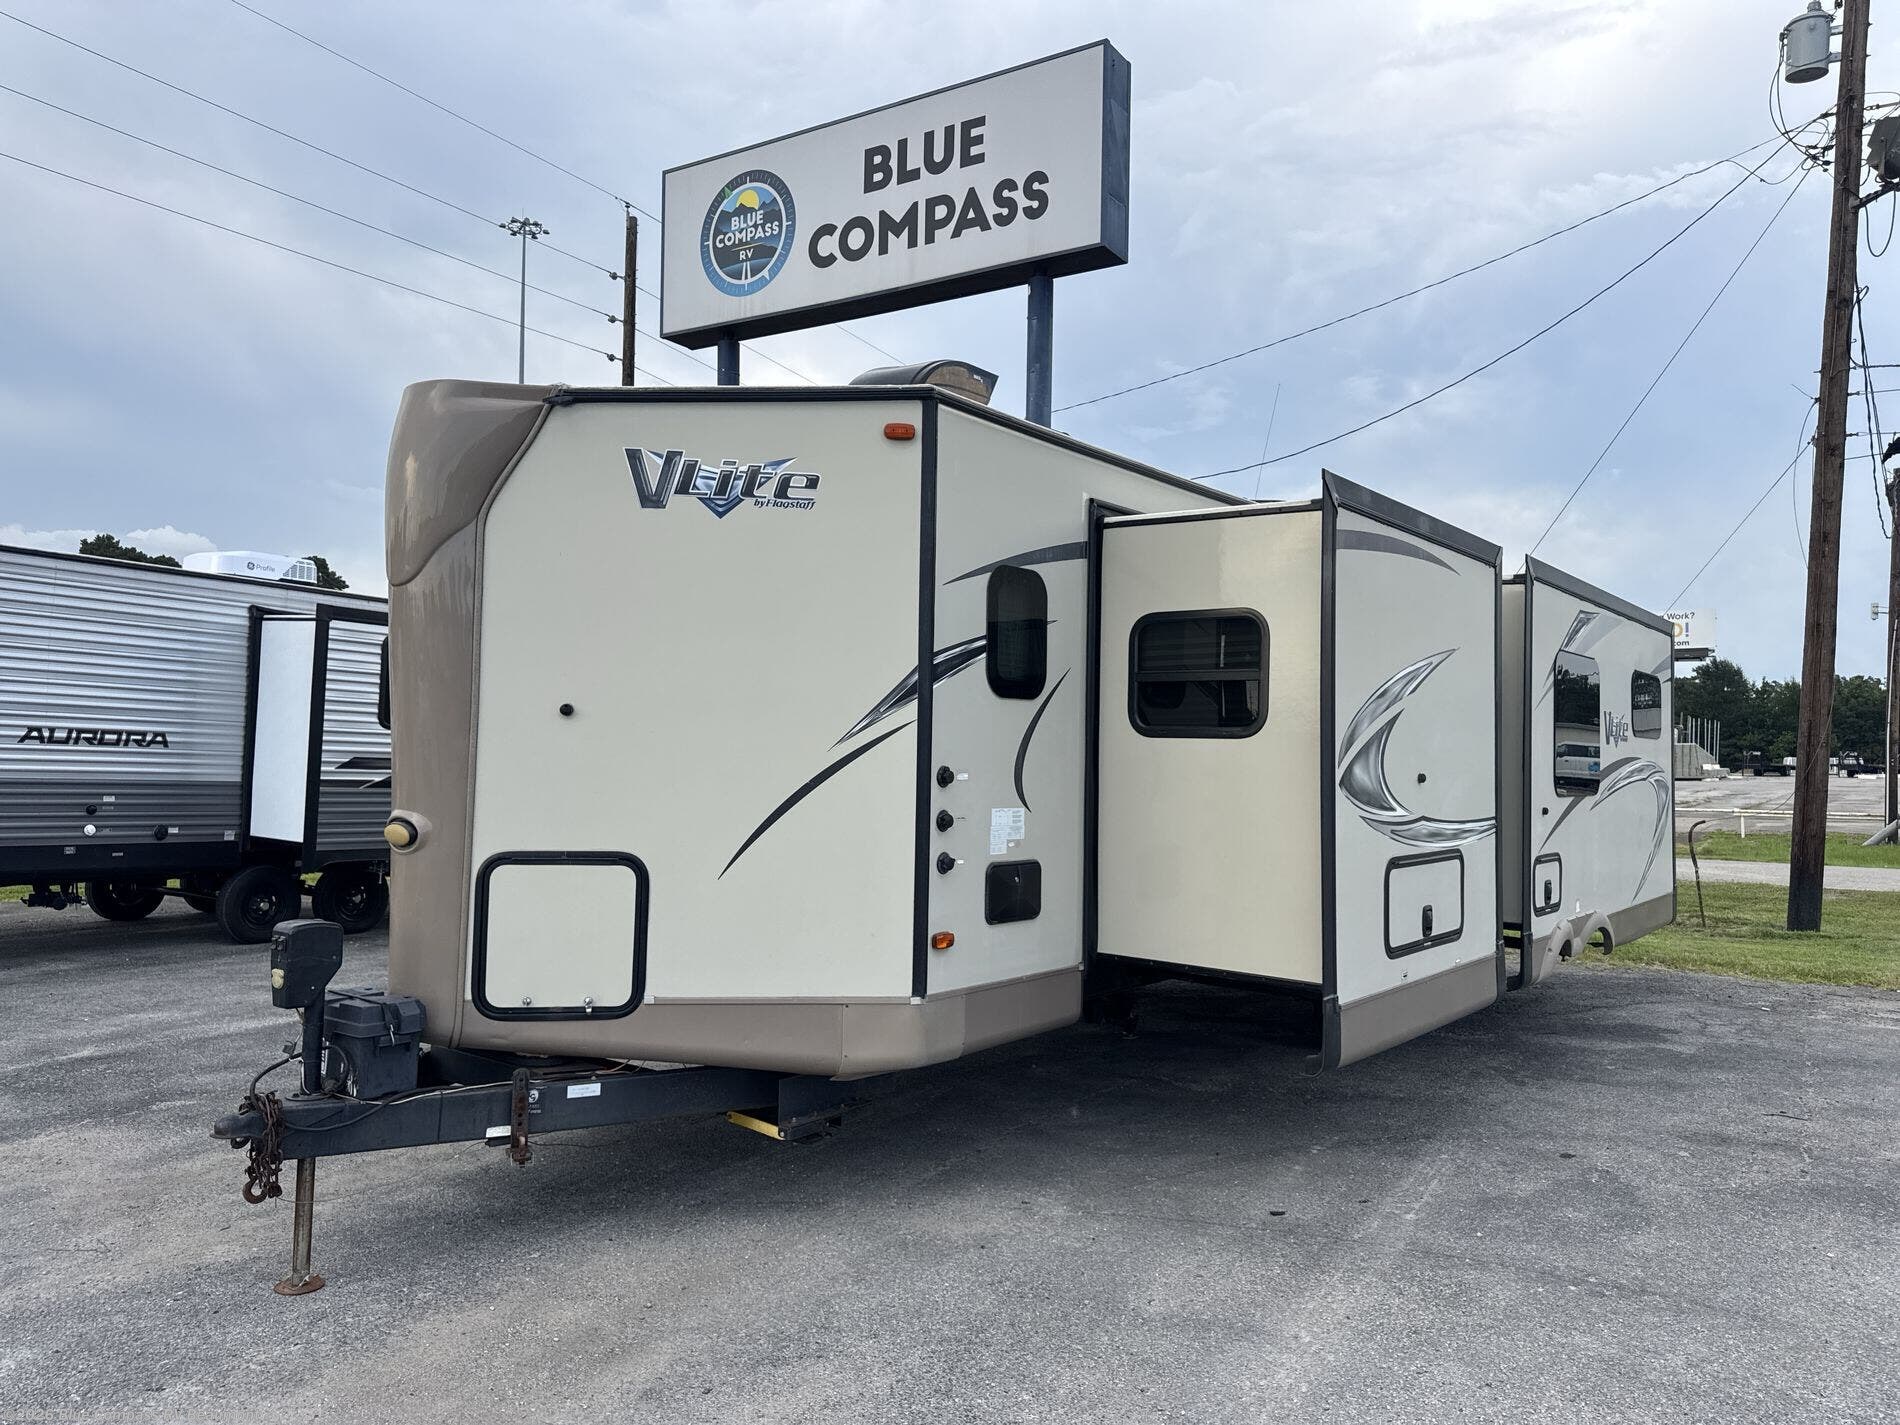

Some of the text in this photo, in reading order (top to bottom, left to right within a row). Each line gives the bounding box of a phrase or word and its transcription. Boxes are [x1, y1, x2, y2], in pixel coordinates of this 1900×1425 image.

[863, 115, 986, 194] BLUE
[731, 210, 764, 231] BLUE
[808, 170, 1050, 269] COMPASS
[716, 221, 780, 249] COMPASS
[739, 248, 754, 261] RV
[1666, 612, 1696, 620] Work?
[17, 726, 170, 748] AURORA
